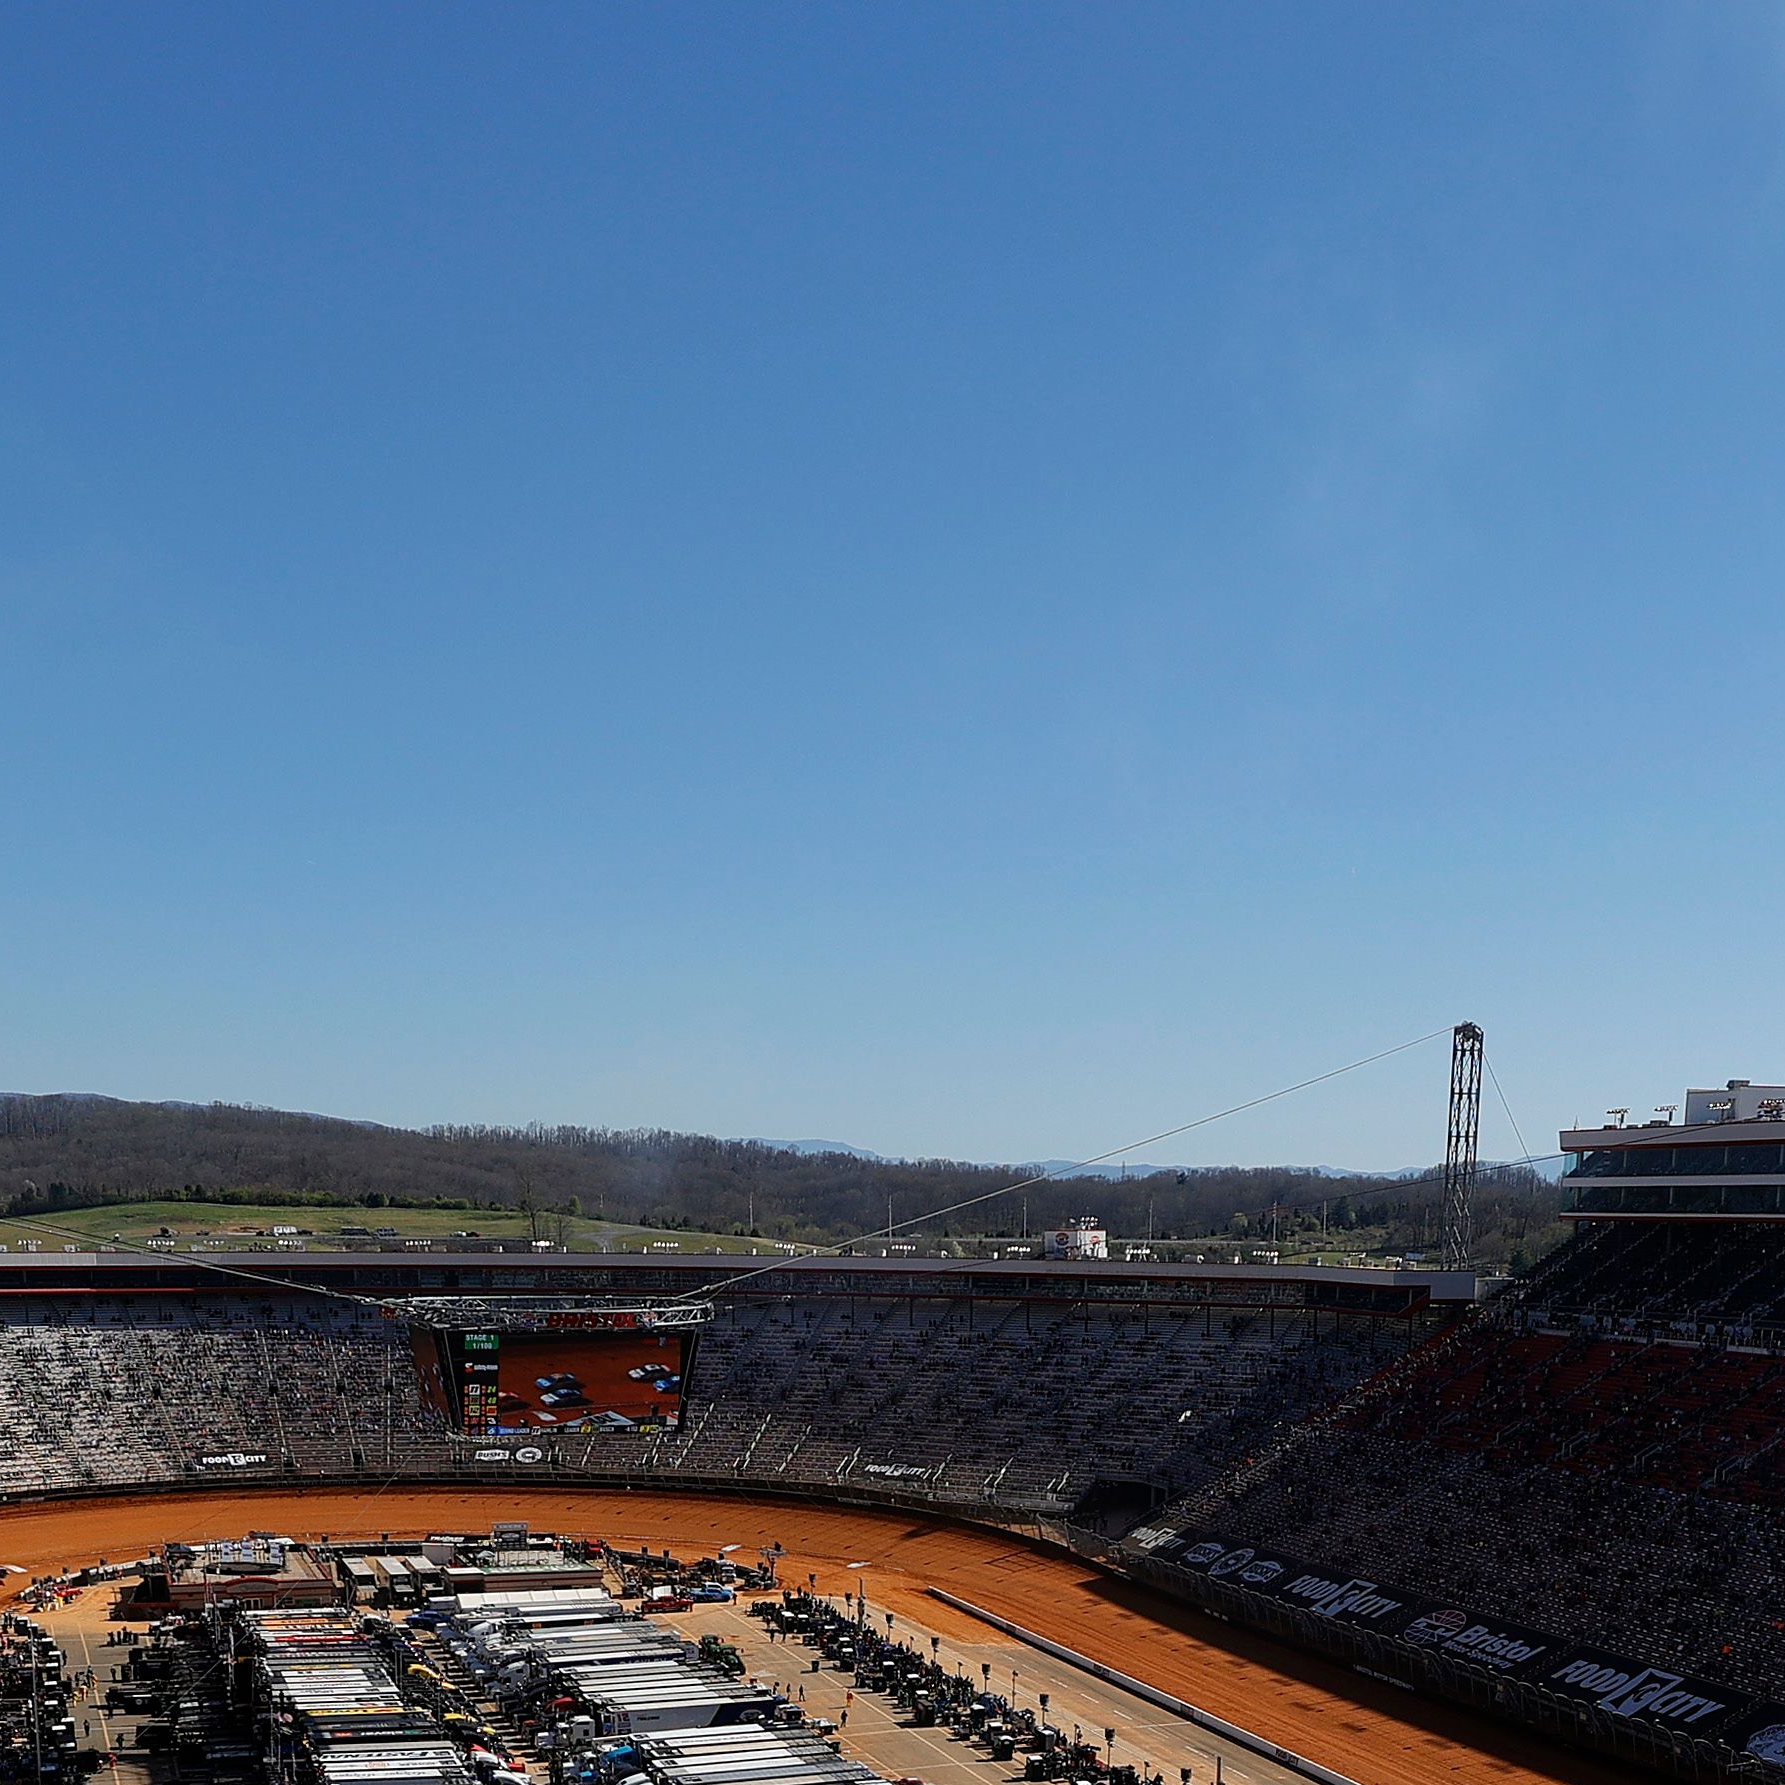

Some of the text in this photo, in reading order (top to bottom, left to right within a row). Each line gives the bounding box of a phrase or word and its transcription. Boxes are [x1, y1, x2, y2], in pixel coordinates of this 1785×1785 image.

[246, 1455, 266, 1463] CITY
[1283, 1574, 1403, 1618] FOOD CITY
[1457, 1624, 1545, 1664] Bristol
[1551, 1659, 1726, 1723] FOOD CITY
